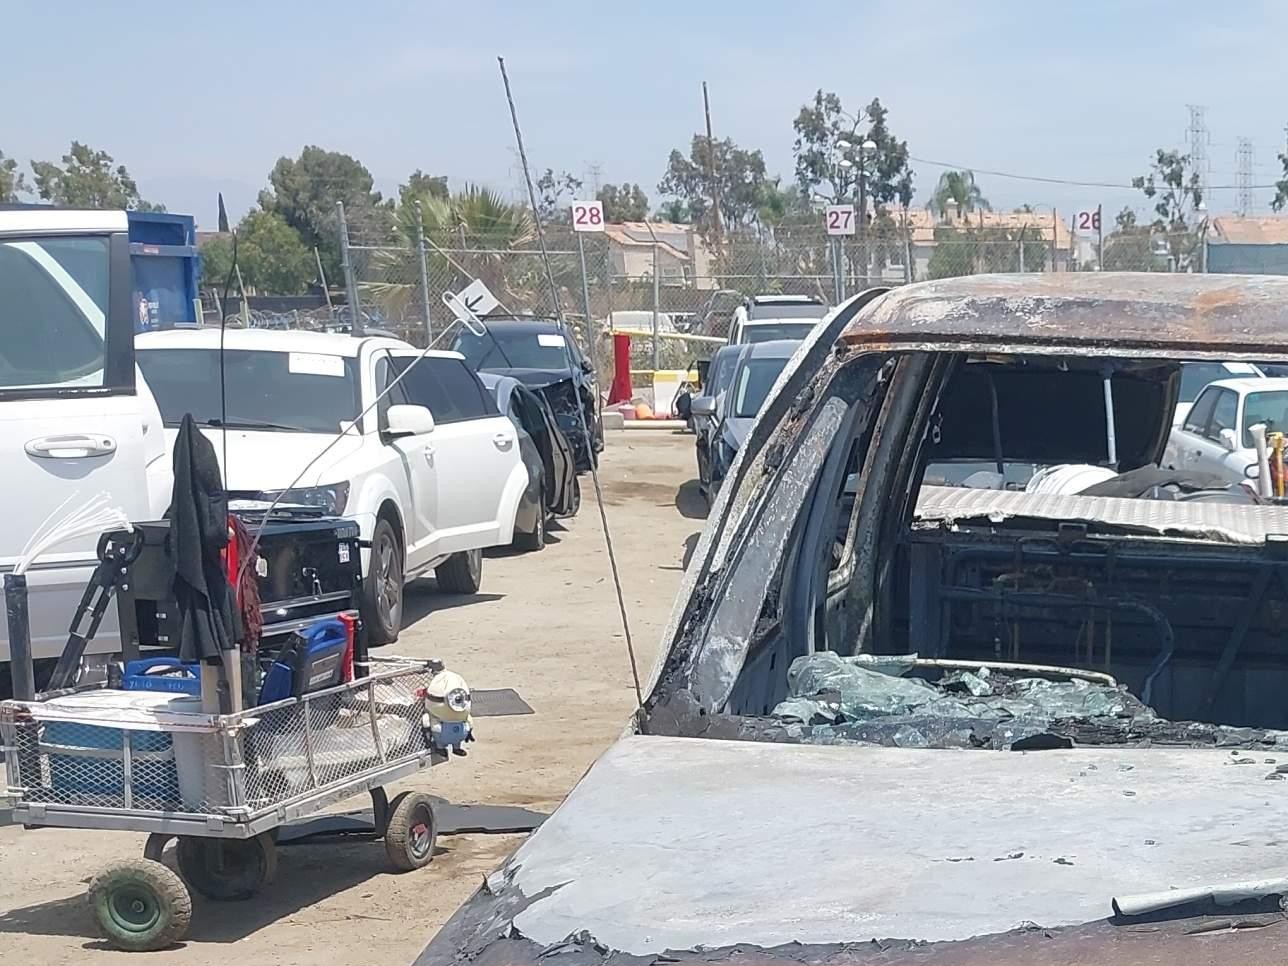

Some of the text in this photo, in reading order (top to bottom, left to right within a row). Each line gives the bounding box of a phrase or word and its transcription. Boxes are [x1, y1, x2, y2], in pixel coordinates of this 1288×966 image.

[575, 206, 601, 225] 28
[829, 211, 852, 229] 27
[1079, 212, 1101, 230] 26
